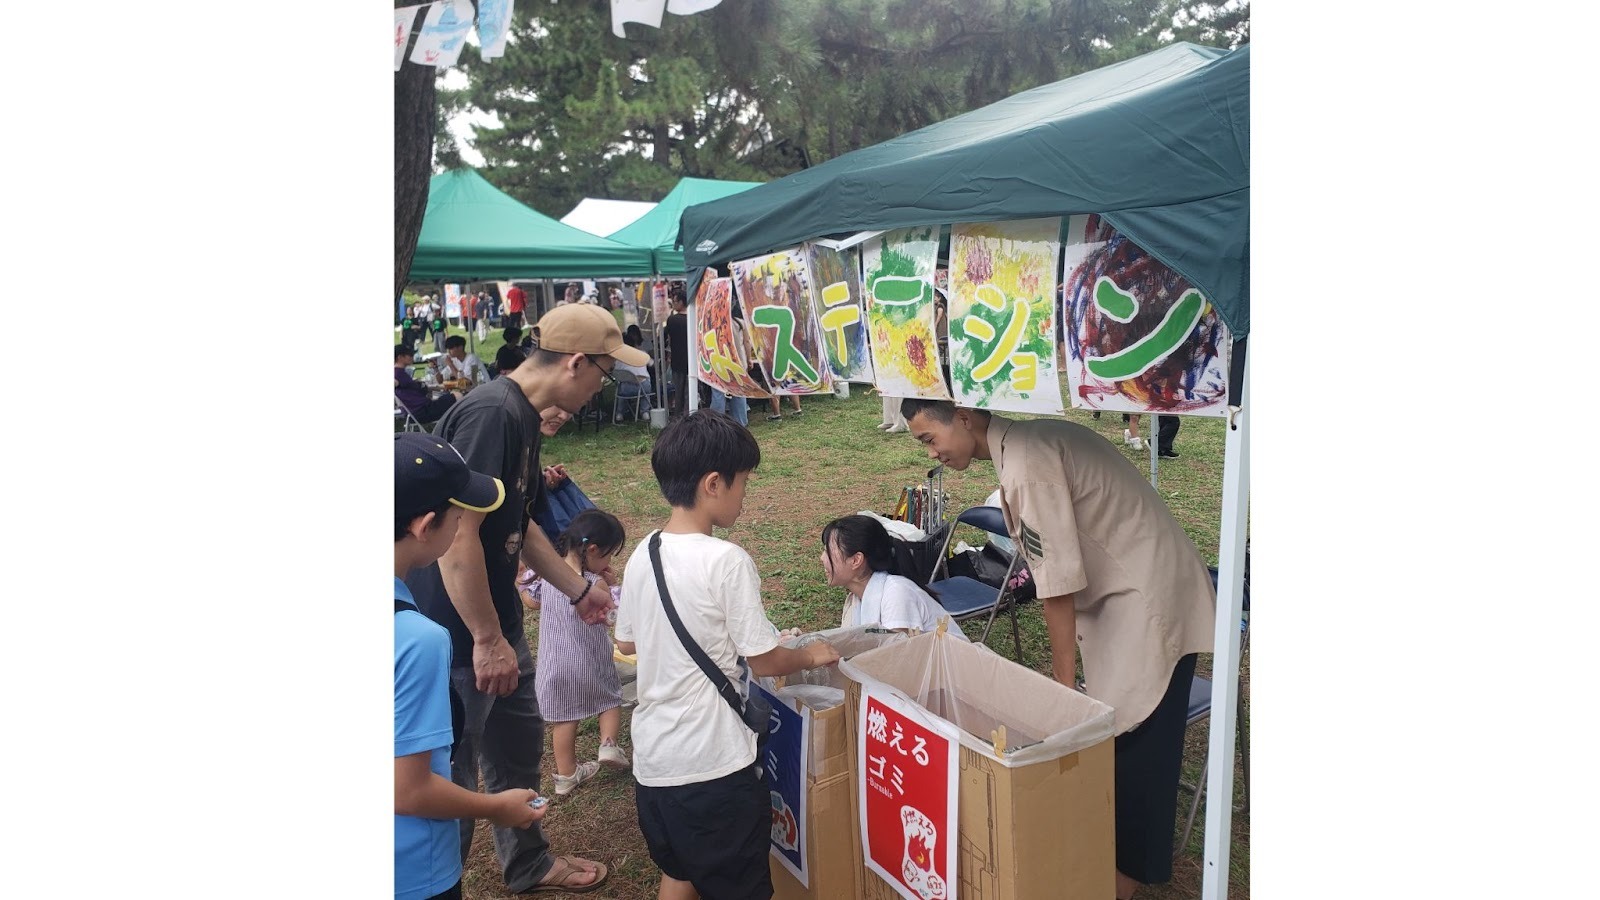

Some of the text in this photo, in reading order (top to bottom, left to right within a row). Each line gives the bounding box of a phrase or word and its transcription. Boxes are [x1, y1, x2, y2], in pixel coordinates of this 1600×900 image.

[698, 276, 1206, 391] みステーション
[867, 706, 930, 766] 燃える
[869, 754, 905, 796] ゴミ
